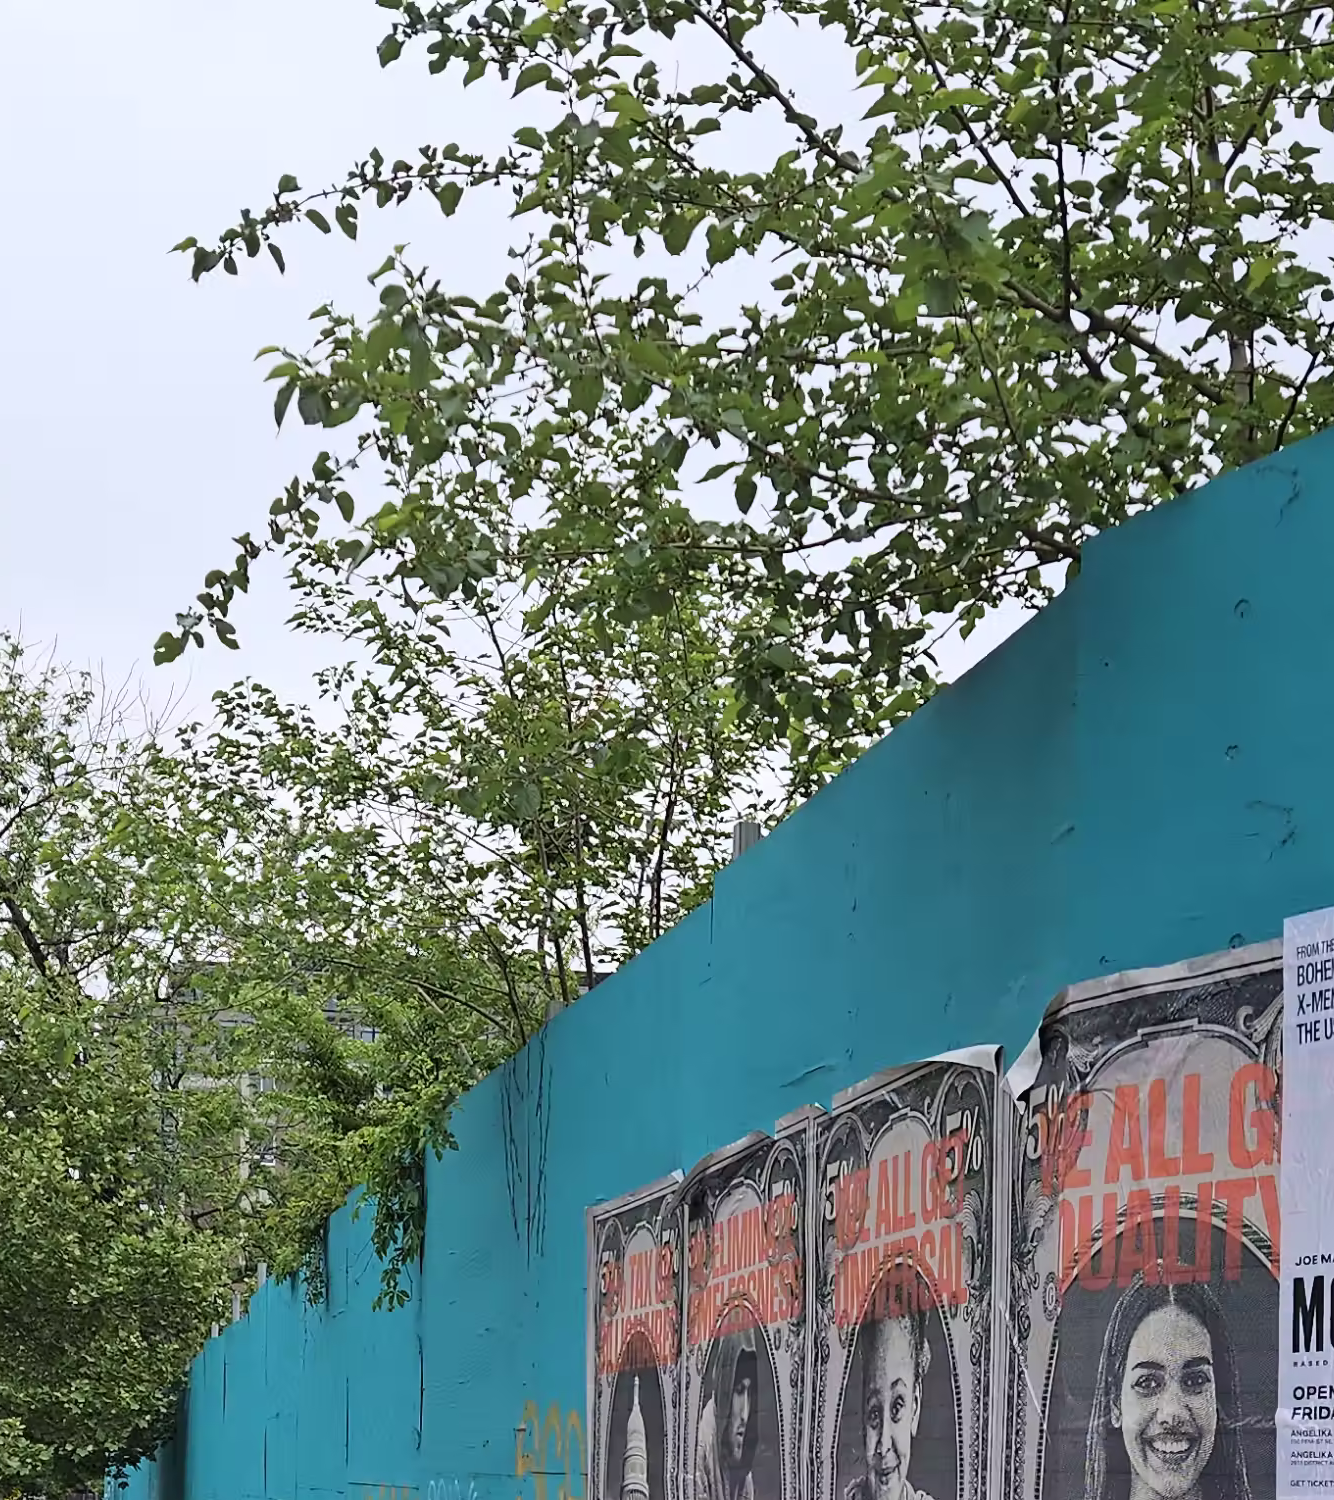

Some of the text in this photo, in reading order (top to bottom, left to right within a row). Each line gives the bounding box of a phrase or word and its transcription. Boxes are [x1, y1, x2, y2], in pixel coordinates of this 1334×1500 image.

[1297, 1019, 1321, 1045] THE
[1103, 1073, 1214, 1187] ALL
[874, 1150, 917, 1239] ALL
